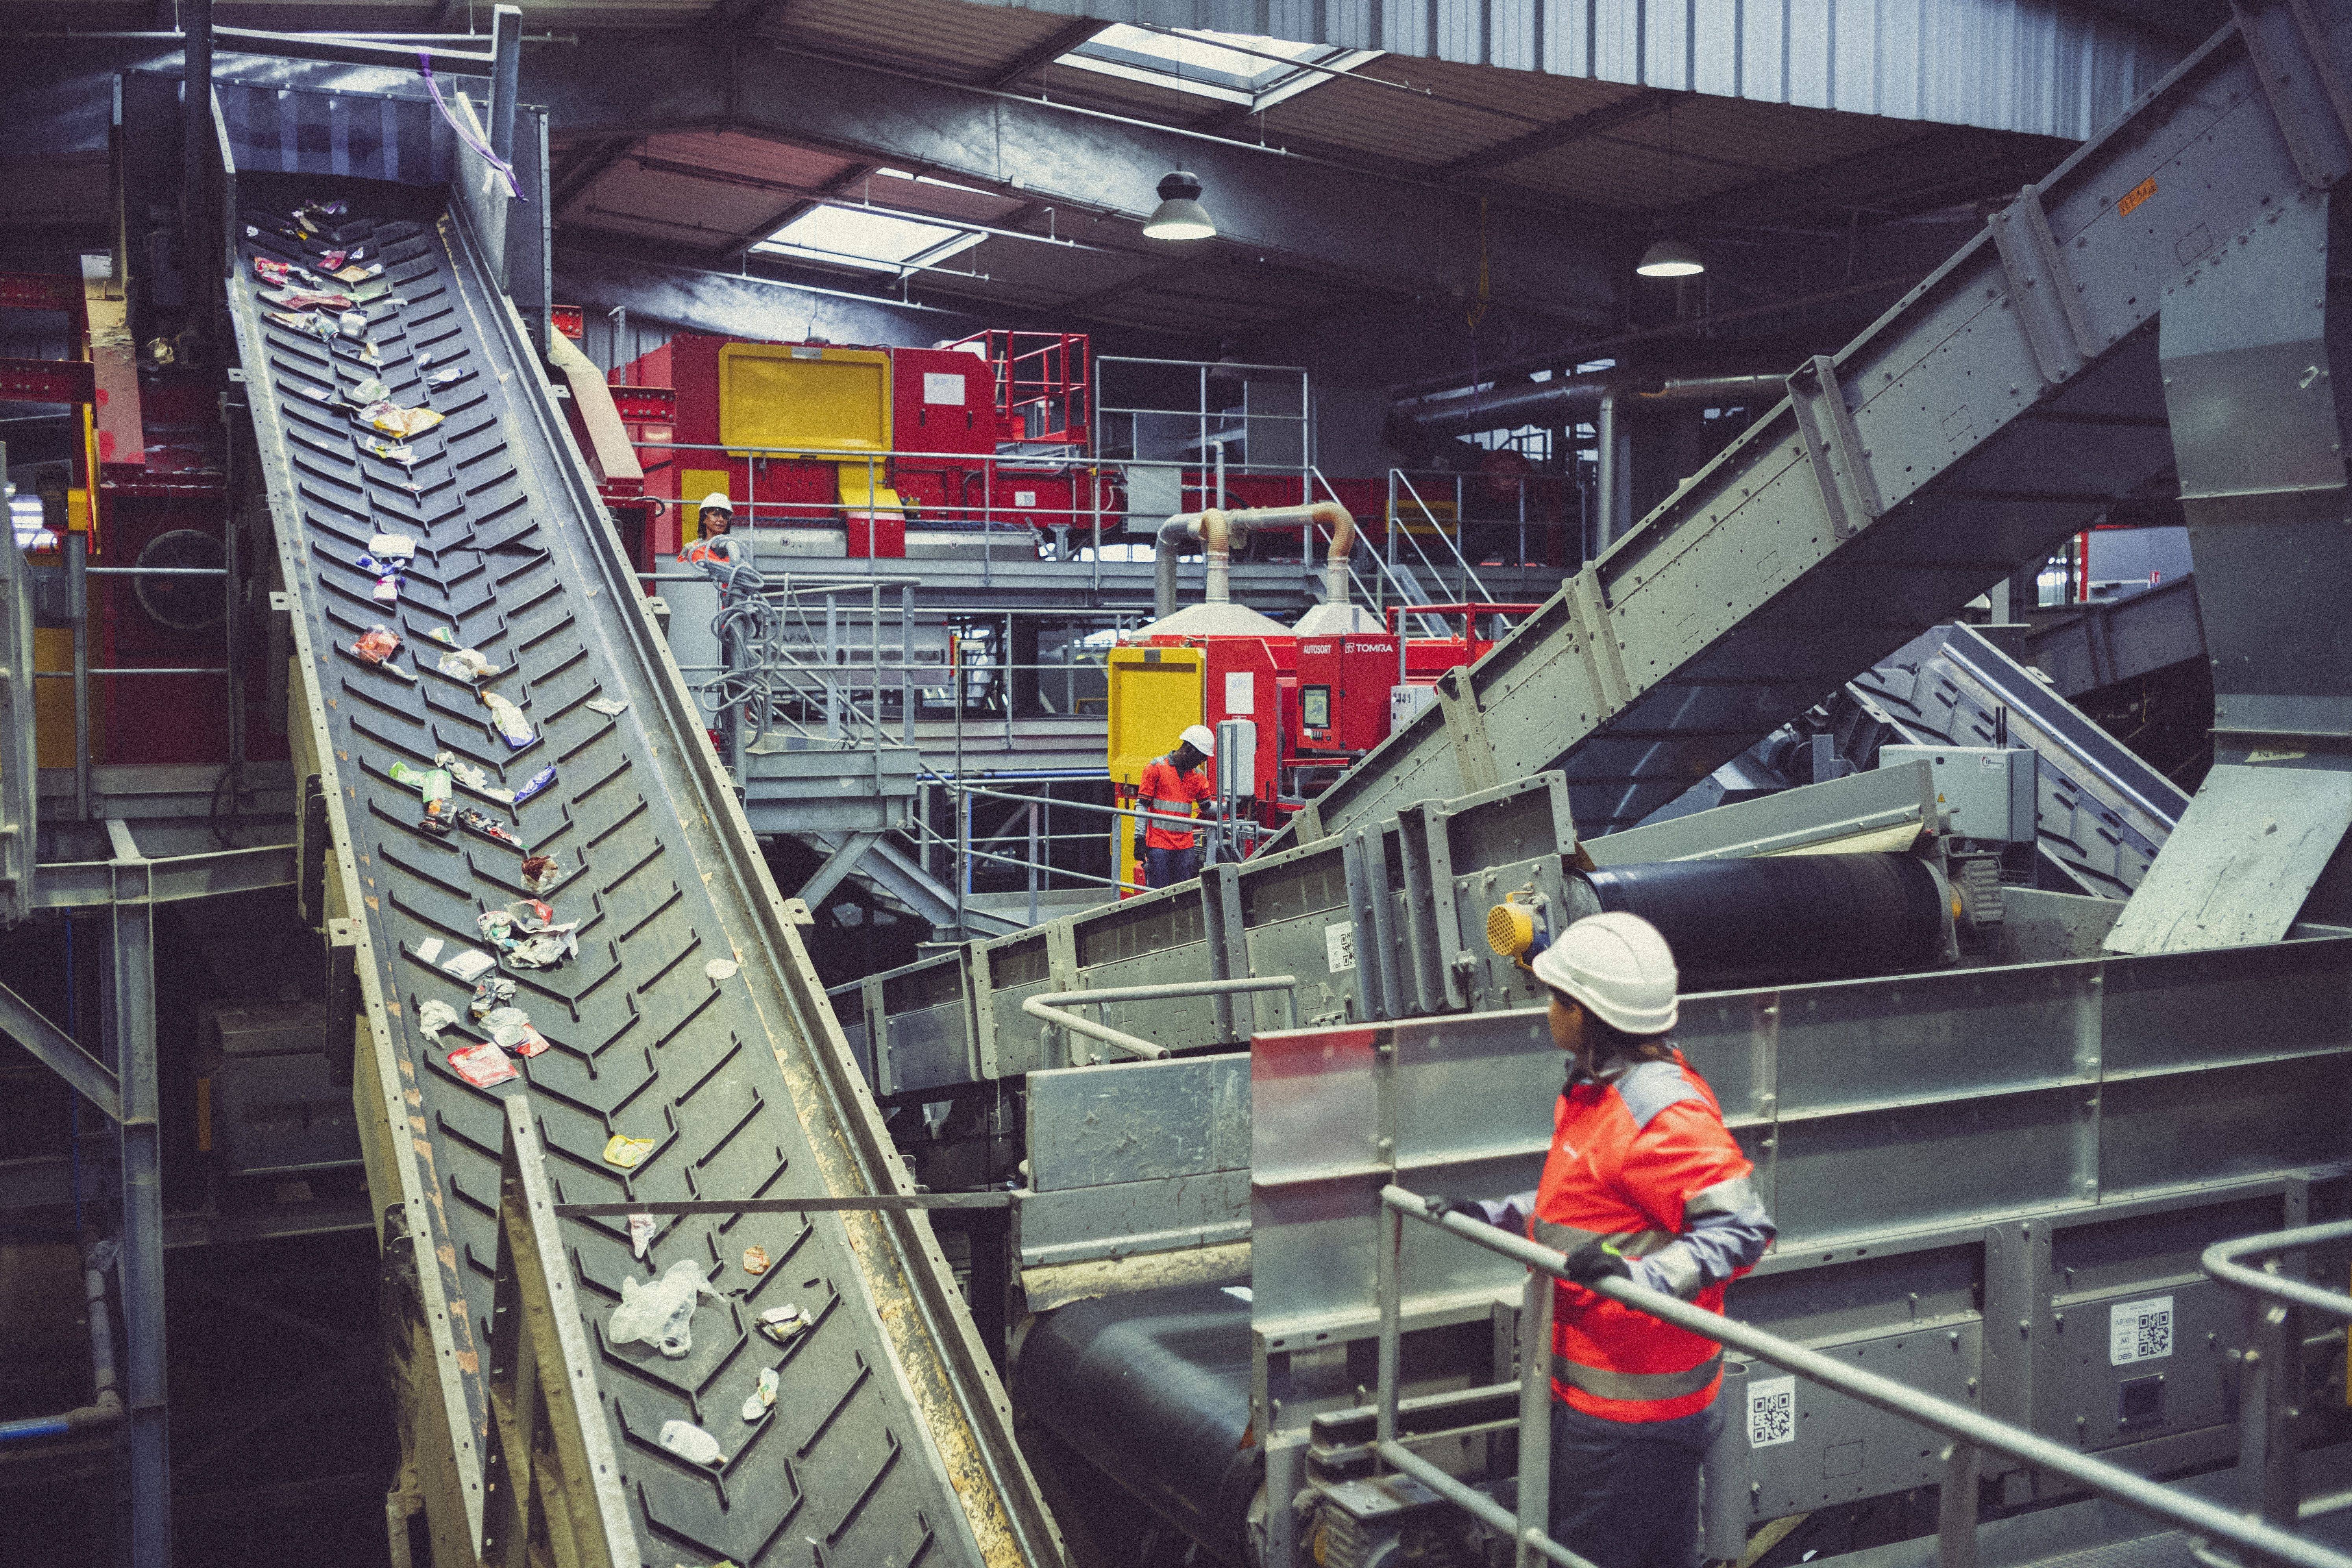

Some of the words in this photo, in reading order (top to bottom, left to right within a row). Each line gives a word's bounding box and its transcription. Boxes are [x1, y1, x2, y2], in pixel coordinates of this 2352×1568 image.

[2119, 194, 2135, 212] REP
[1303, 645, 1331, 654] AUTOSORT
[1355, 644, 1393, 652] TOMRA
